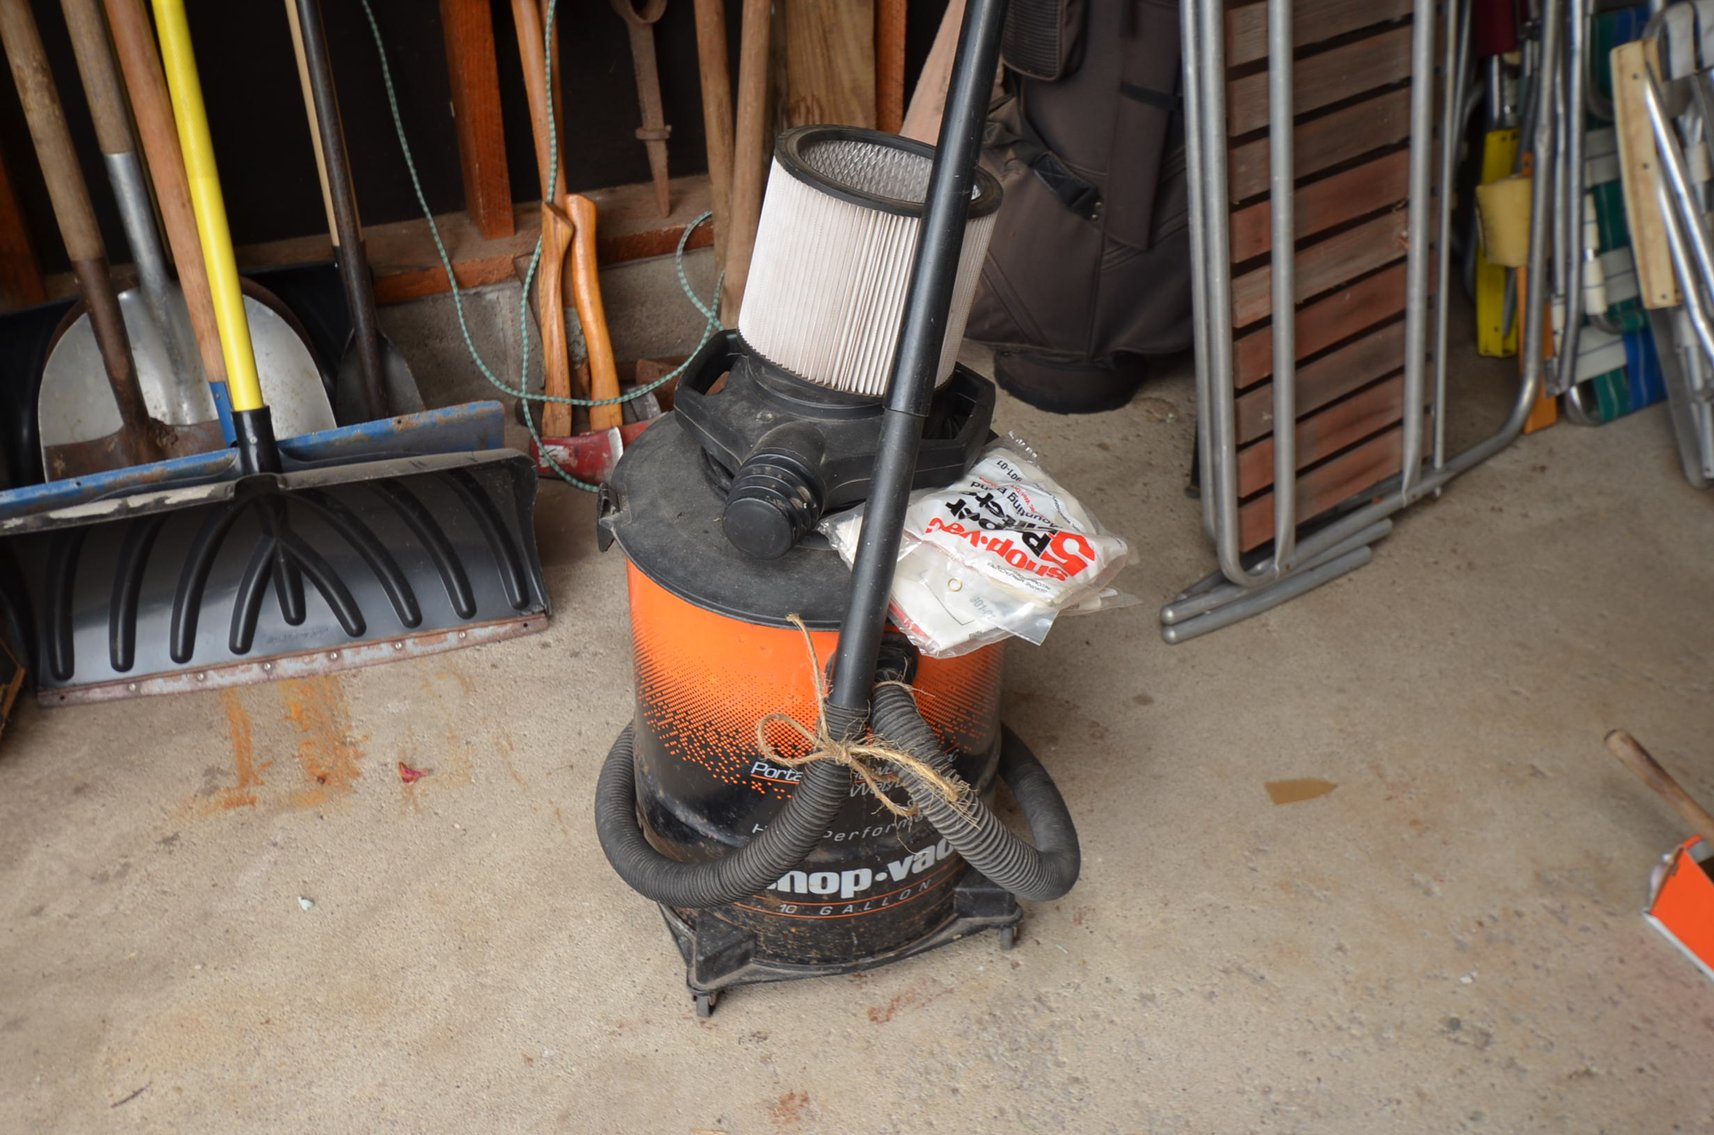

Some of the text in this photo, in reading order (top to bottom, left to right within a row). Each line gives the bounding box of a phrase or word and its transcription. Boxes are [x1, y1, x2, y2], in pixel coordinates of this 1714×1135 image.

[1040, 530, 1096, 577] 5
[778, 879, 932, 916] 10 GALLON
